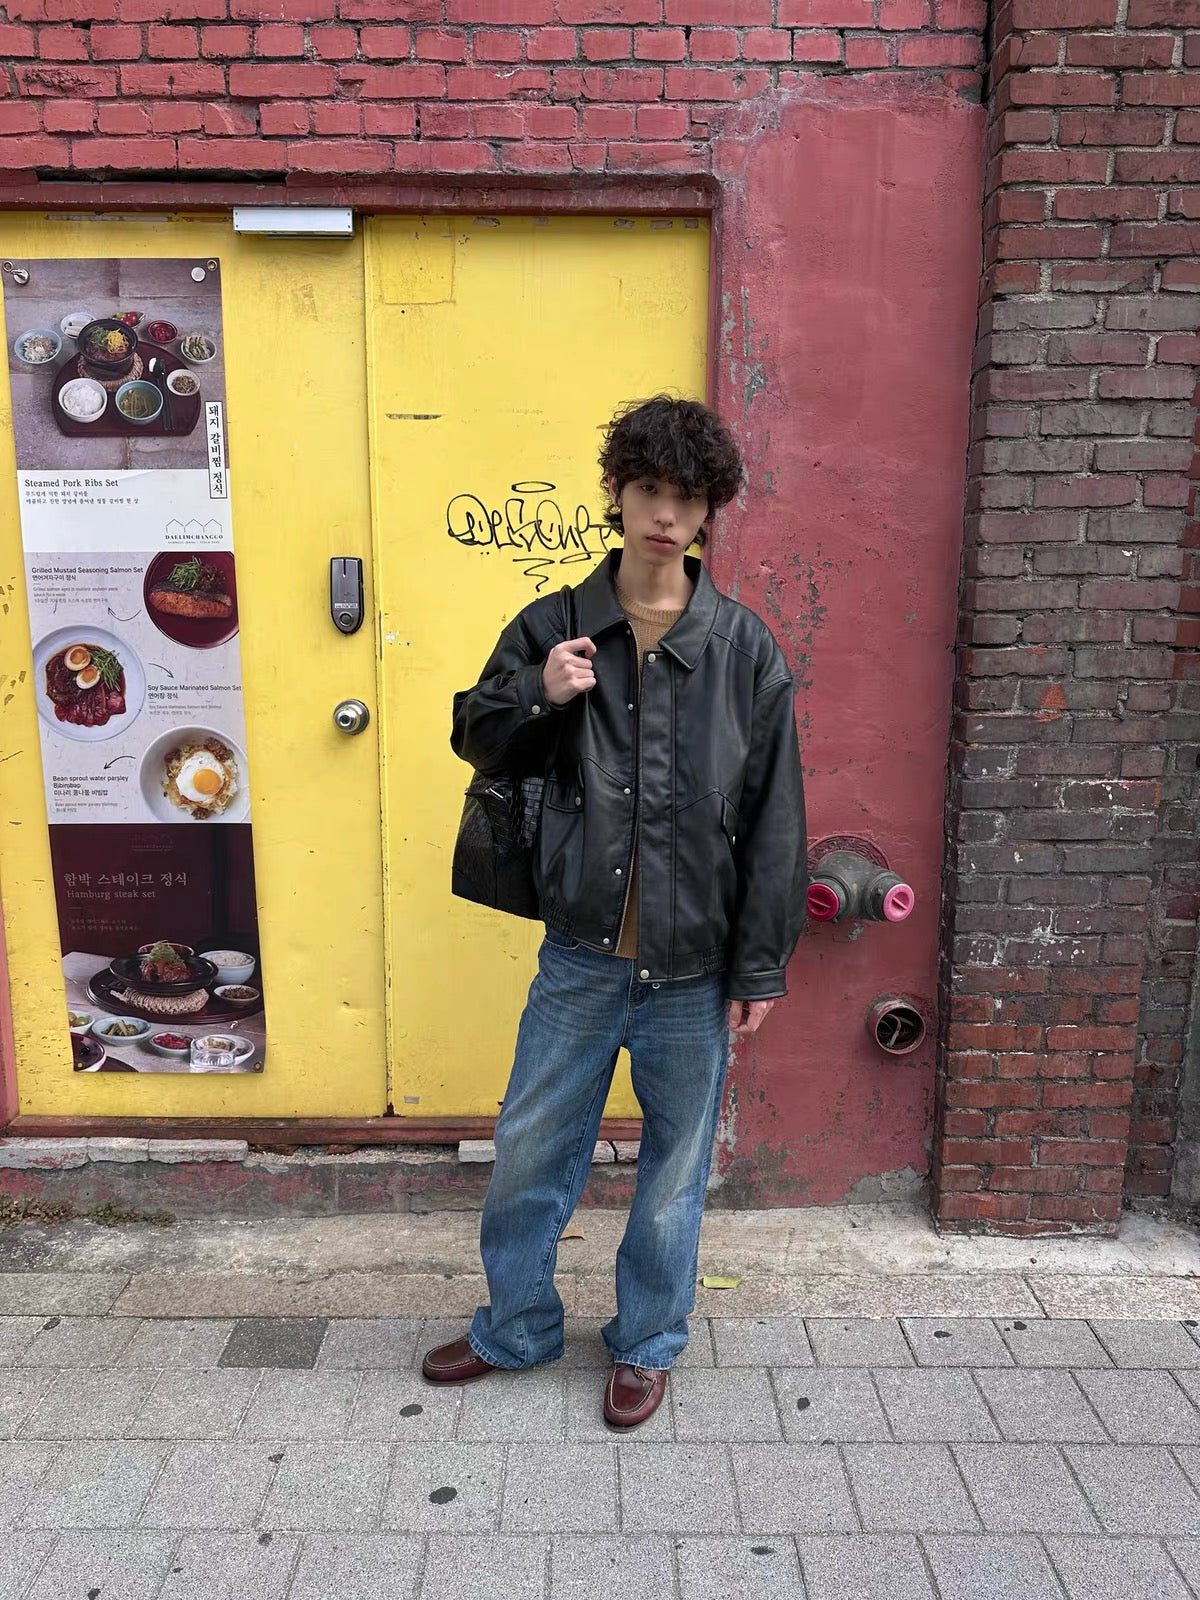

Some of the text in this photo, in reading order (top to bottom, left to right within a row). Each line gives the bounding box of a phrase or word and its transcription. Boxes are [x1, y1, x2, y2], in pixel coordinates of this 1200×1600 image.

[208, 404, 222, 495] 돼지 갈비찜 정식
[24, 479, 60, 487] Steamed
[63, 478, 82, 487] Pork
[85, 478, 102, 486] Ribs
[167, 692, 178, 700] 정식
[64, 872, 187, 886] 함박 스테이크 정식
[67, 890, 156, 900] Hamburg steak set
